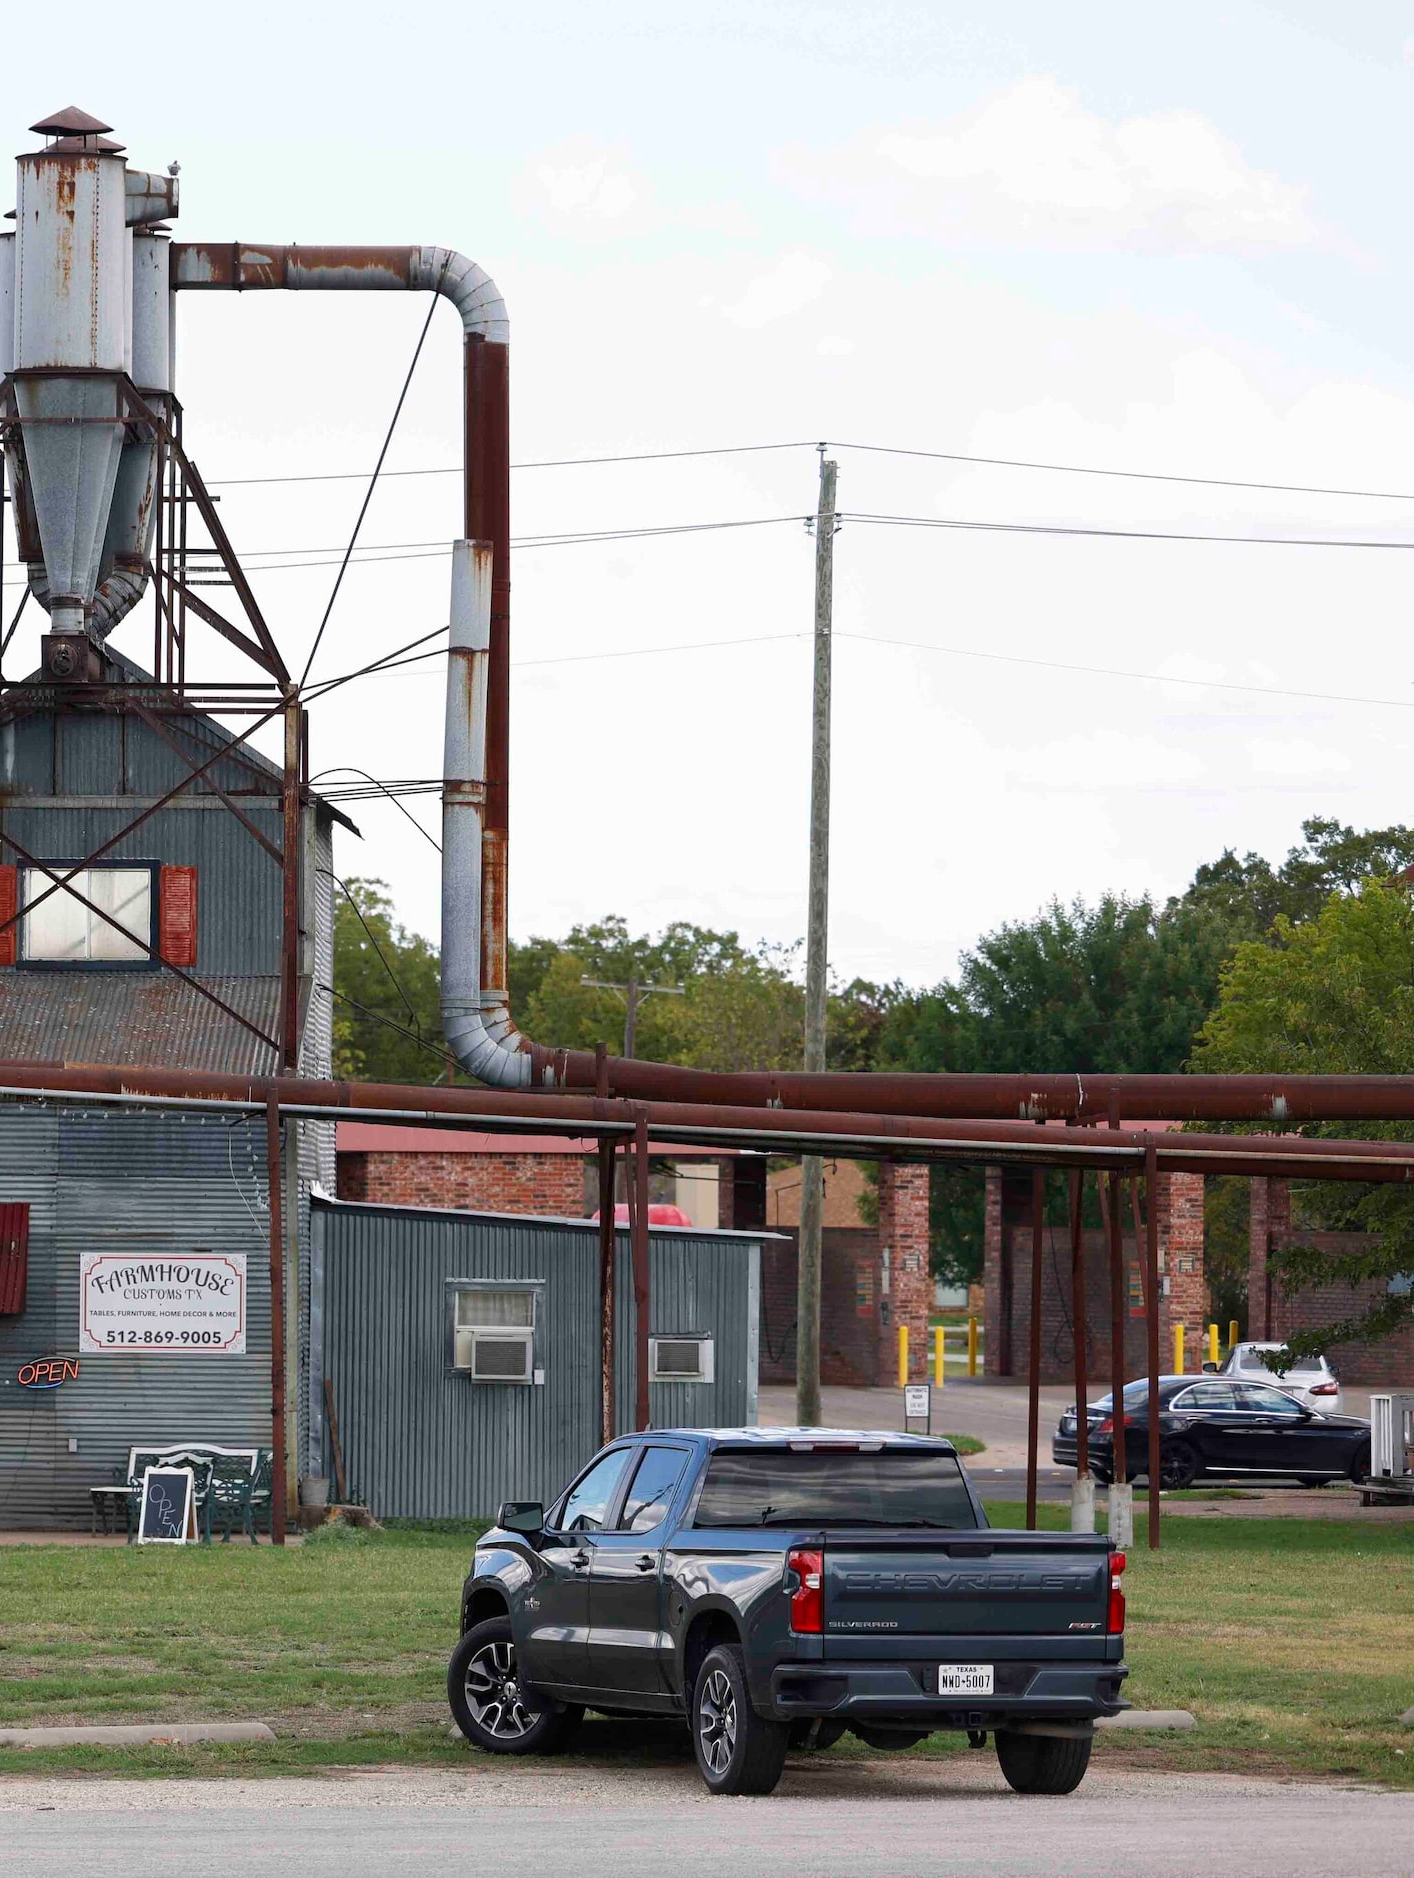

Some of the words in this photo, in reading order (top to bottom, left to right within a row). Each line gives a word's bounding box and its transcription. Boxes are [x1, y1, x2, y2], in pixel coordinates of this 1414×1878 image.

[91, 1263, 235, 1296] FARMHOUSE
[123, 1288, 182, 1300] CUSTOMS
[185, 1288, 203, 1300] TX
[90, 1310, 117, 1318] TABLES,
[118, 1310, 158, 1318] FURNITURE,
[106, 1330, 222, 1344] 512-869-9005
[18, 1360, 79, 1385] OPEN
[149, 1483, 183, 1538] OPEN
[846, 1574, 1091, 1590] CHEVROLET
